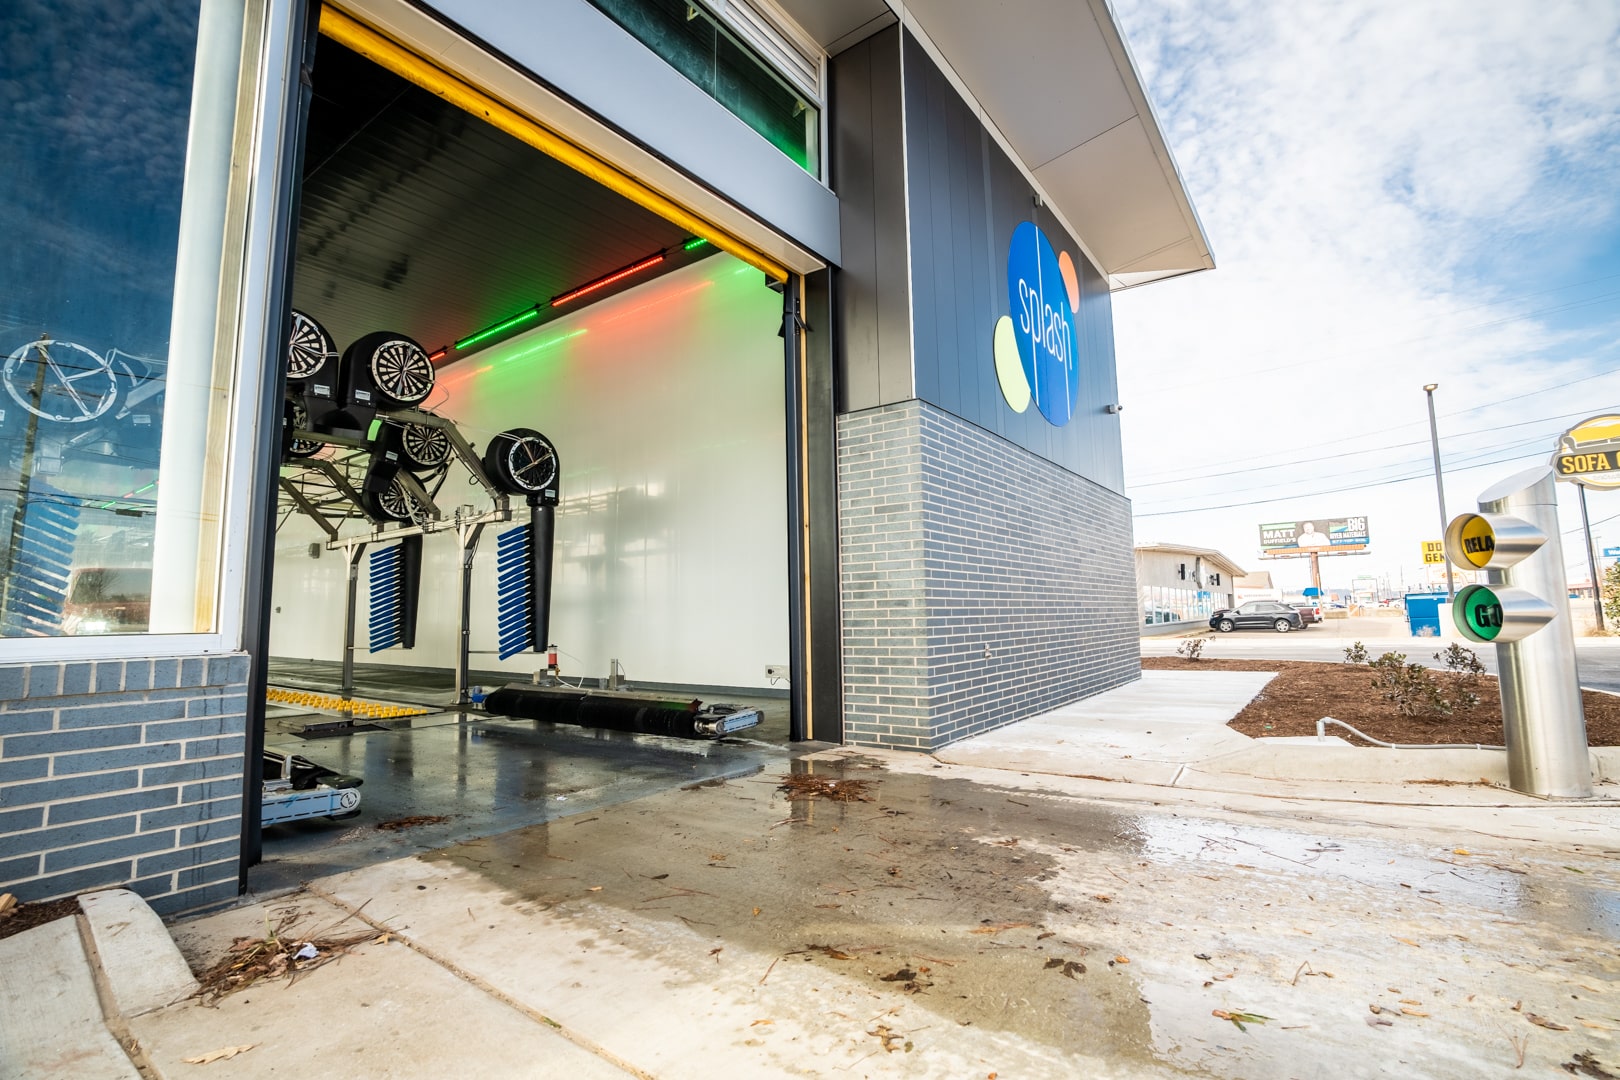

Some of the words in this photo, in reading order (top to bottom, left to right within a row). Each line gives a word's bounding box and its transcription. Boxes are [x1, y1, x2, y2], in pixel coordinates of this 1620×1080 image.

[1562, 453, 1611, 474] SOFA
[1347, 517, 1365, 531] BIG
[1263, 529, 1295, 539] MATT
[1475, 603, 1503, 628] GO
